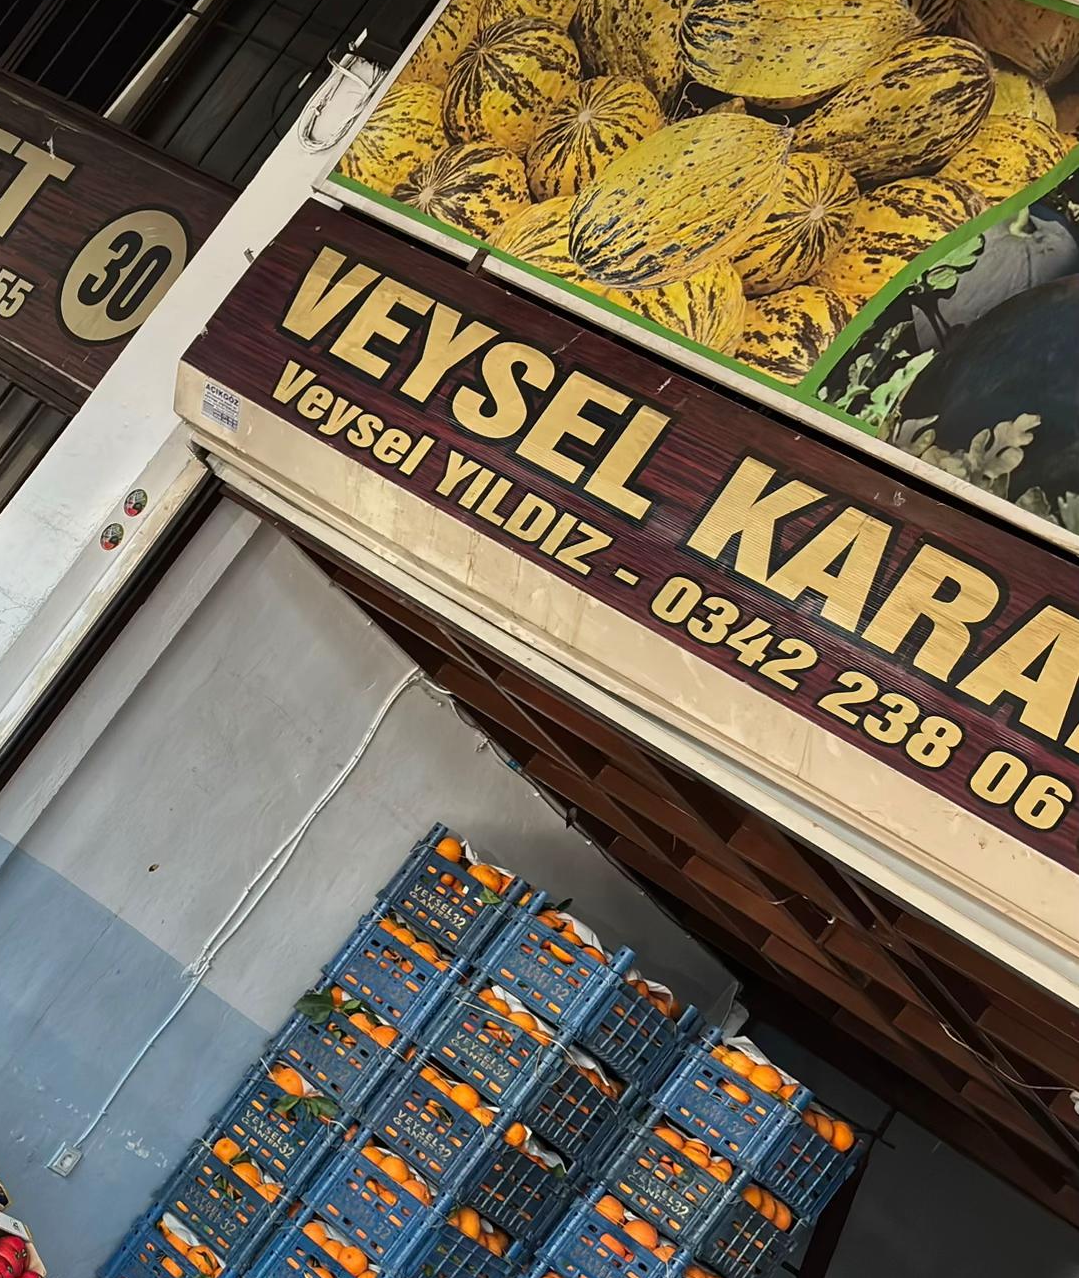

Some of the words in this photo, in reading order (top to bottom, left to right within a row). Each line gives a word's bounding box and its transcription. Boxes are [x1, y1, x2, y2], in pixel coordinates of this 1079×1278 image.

[76, 230, 172, 322] 30
[281, 244, 673, 522] VEYSEL
[686, 454, 1079, 752] KARA
[270, 359, 436, 477] Veysel
[434, 449, 615, 577] YILDIZ
[650, 574, 821, 692] 0342
[817, 670, 965, 769] 238
[968, 749, 1074, 831] 06
[413, 883, 454, 917] VEYSEL
[450, 912, 467, 930] 32
[550, 983, 570, 1002] 32
[245, 1109, 282, 1145] VEYSEL
[397, 1109, 440, 1148] VEYSEL
[279, 1142, 295, 1160] 32
[437, 1141, 453, 1161] 32
[670, 1201, 690, 1219] 32
[219, 1218, 237, 1236] 32
